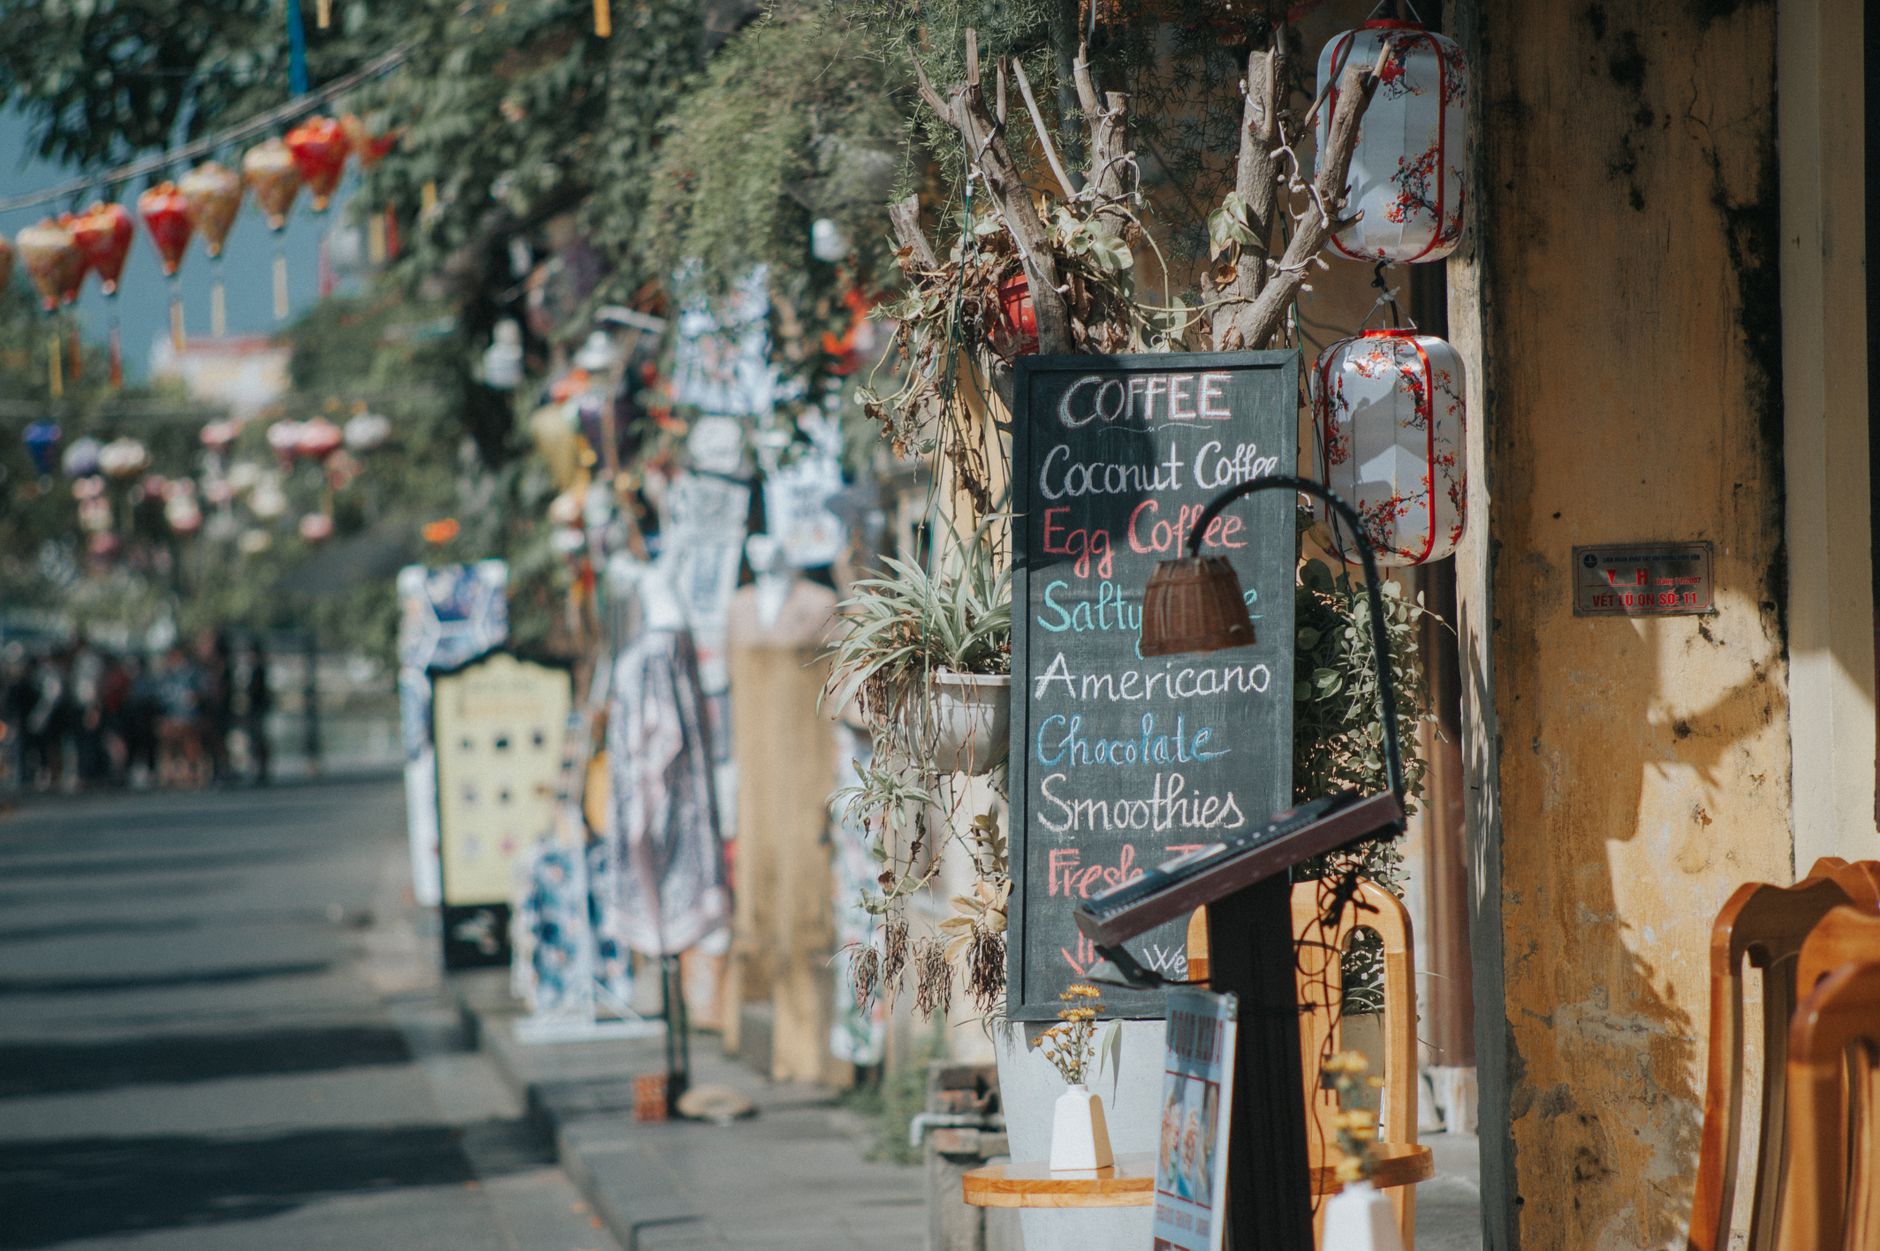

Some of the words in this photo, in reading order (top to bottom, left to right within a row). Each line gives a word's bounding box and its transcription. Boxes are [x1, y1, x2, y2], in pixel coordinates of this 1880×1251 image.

[1057, 370, 1233, 428] COFFEE
[1039, 441, 1184, 500] Coconut
[1043, 505, 1116, 578] Egg
[1037, 580, 1144, 660] Salty
[1034, 651, 1271, 701] Americano
[1037, 712, 1231, 767] Chocolate
[1037, 773, 1246, 833] Smoothies
